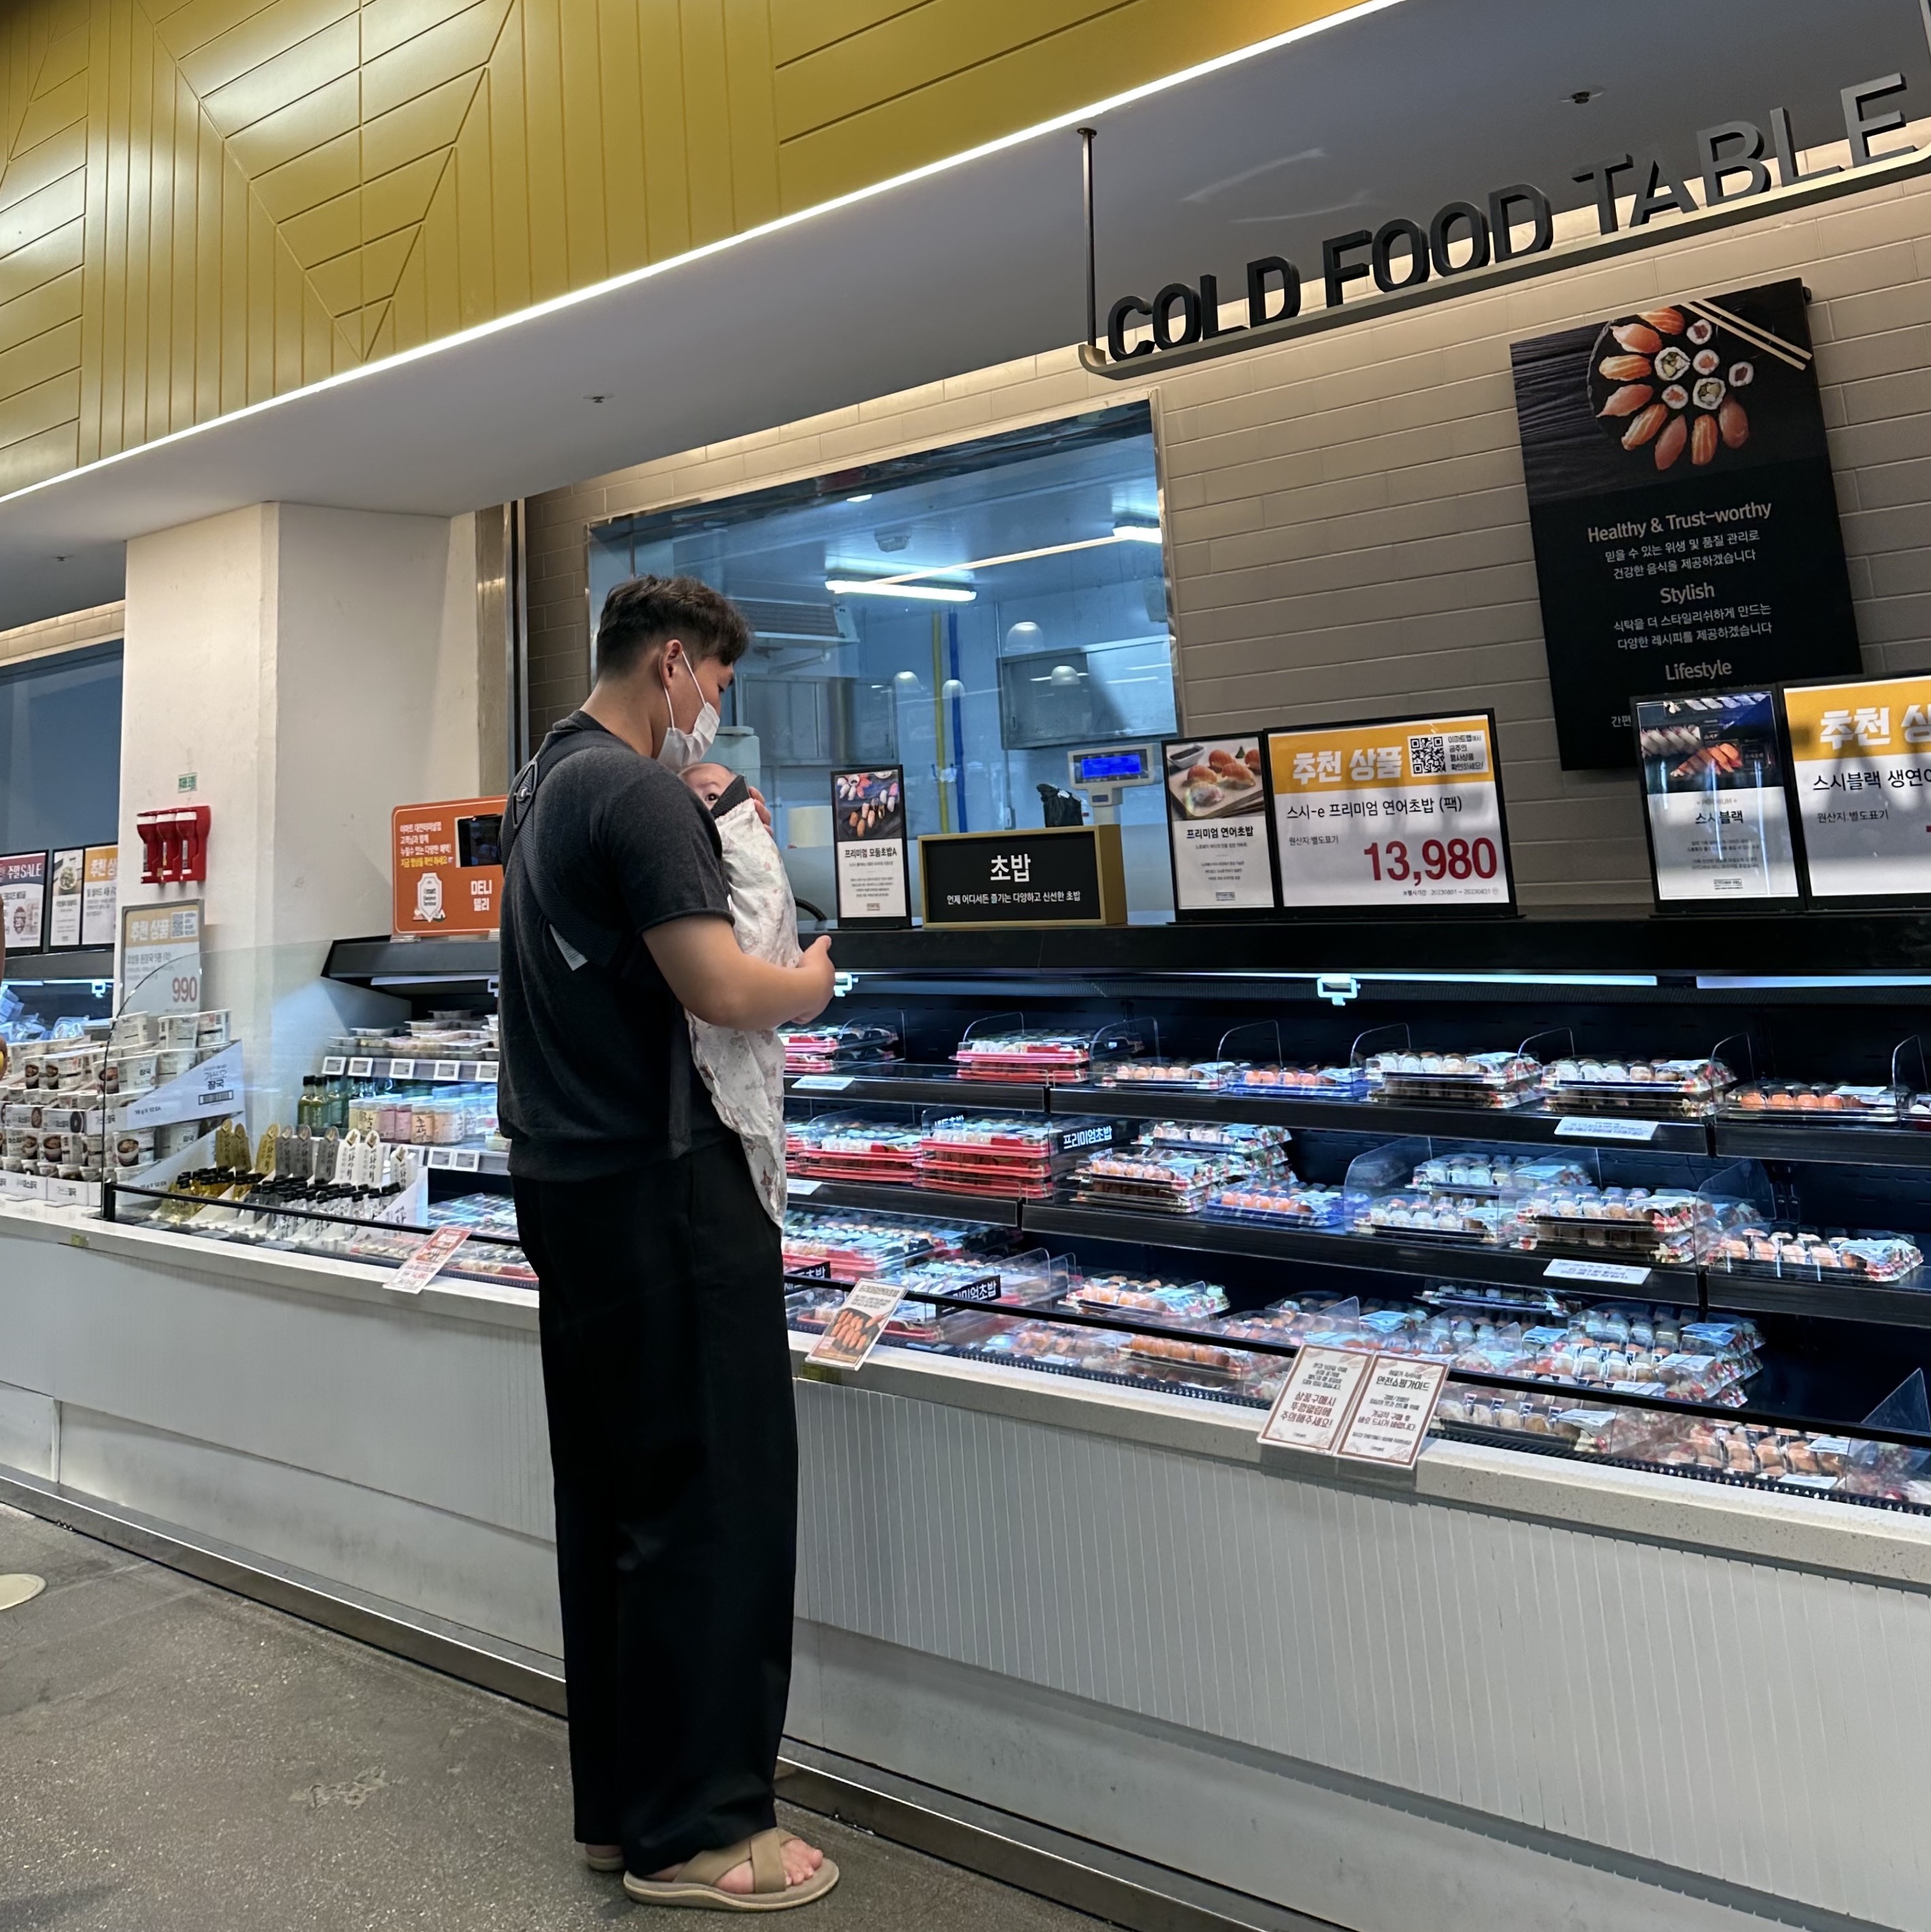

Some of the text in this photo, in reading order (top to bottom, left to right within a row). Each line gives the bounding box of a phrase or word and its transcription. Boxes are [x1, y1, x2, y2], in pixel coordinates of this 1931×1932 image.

[1108, 72, 1917, 362] COLD FOOD TABLE
[1587, 502, 1772, 543] Healthy & Trust-worthy
[1605, 529, 1760, 563] 믿을 수 있는 위생 및 품질 관리로
[1613, 548, 1756, 580] 건강한 음식을 제공하겠습니다
[1660, 582, 1715, 605] Stylish
[1613, 603, 1772, 632] 식탁을 더 스타일리쉬하게 만드는
[1617, 621, 1773, 650] 다양한 레시피를 제공하겠습니다
[1665, 659, 1733, 681] Lifestyle
[1820, 707, 1891, 750] 추천
[1293, 746, 1403, 786] 추천 상품
[1813, 770, 1881, 791] 스시블랙
[1286, 795, 1462, 819] 스시-e 프리미엄 연어초밥 (팩)
[1186, 825, 1254, 839] 프리미엄 연어초밥
[844, 848, 868, 859] 프리미엄
[1363, 836, 1498, 886] 13,980
[90, 858, 107, 878] 추천
[990, 853, 1031, 882] 초밥
[471, 880, 492, 895] DELI
[947, 891, 1081, 905] 언제 어디서든 즐기는 다양하고 신선한 초밥
[473, 897, 490, 912] 델리
[131, 921, 149, 942] 추천
[151, 919, 169, 940] 상품
[172, 977, 198, 1002] 990
[1063, 1125, 1112, 1150] 프리미엄초밥
